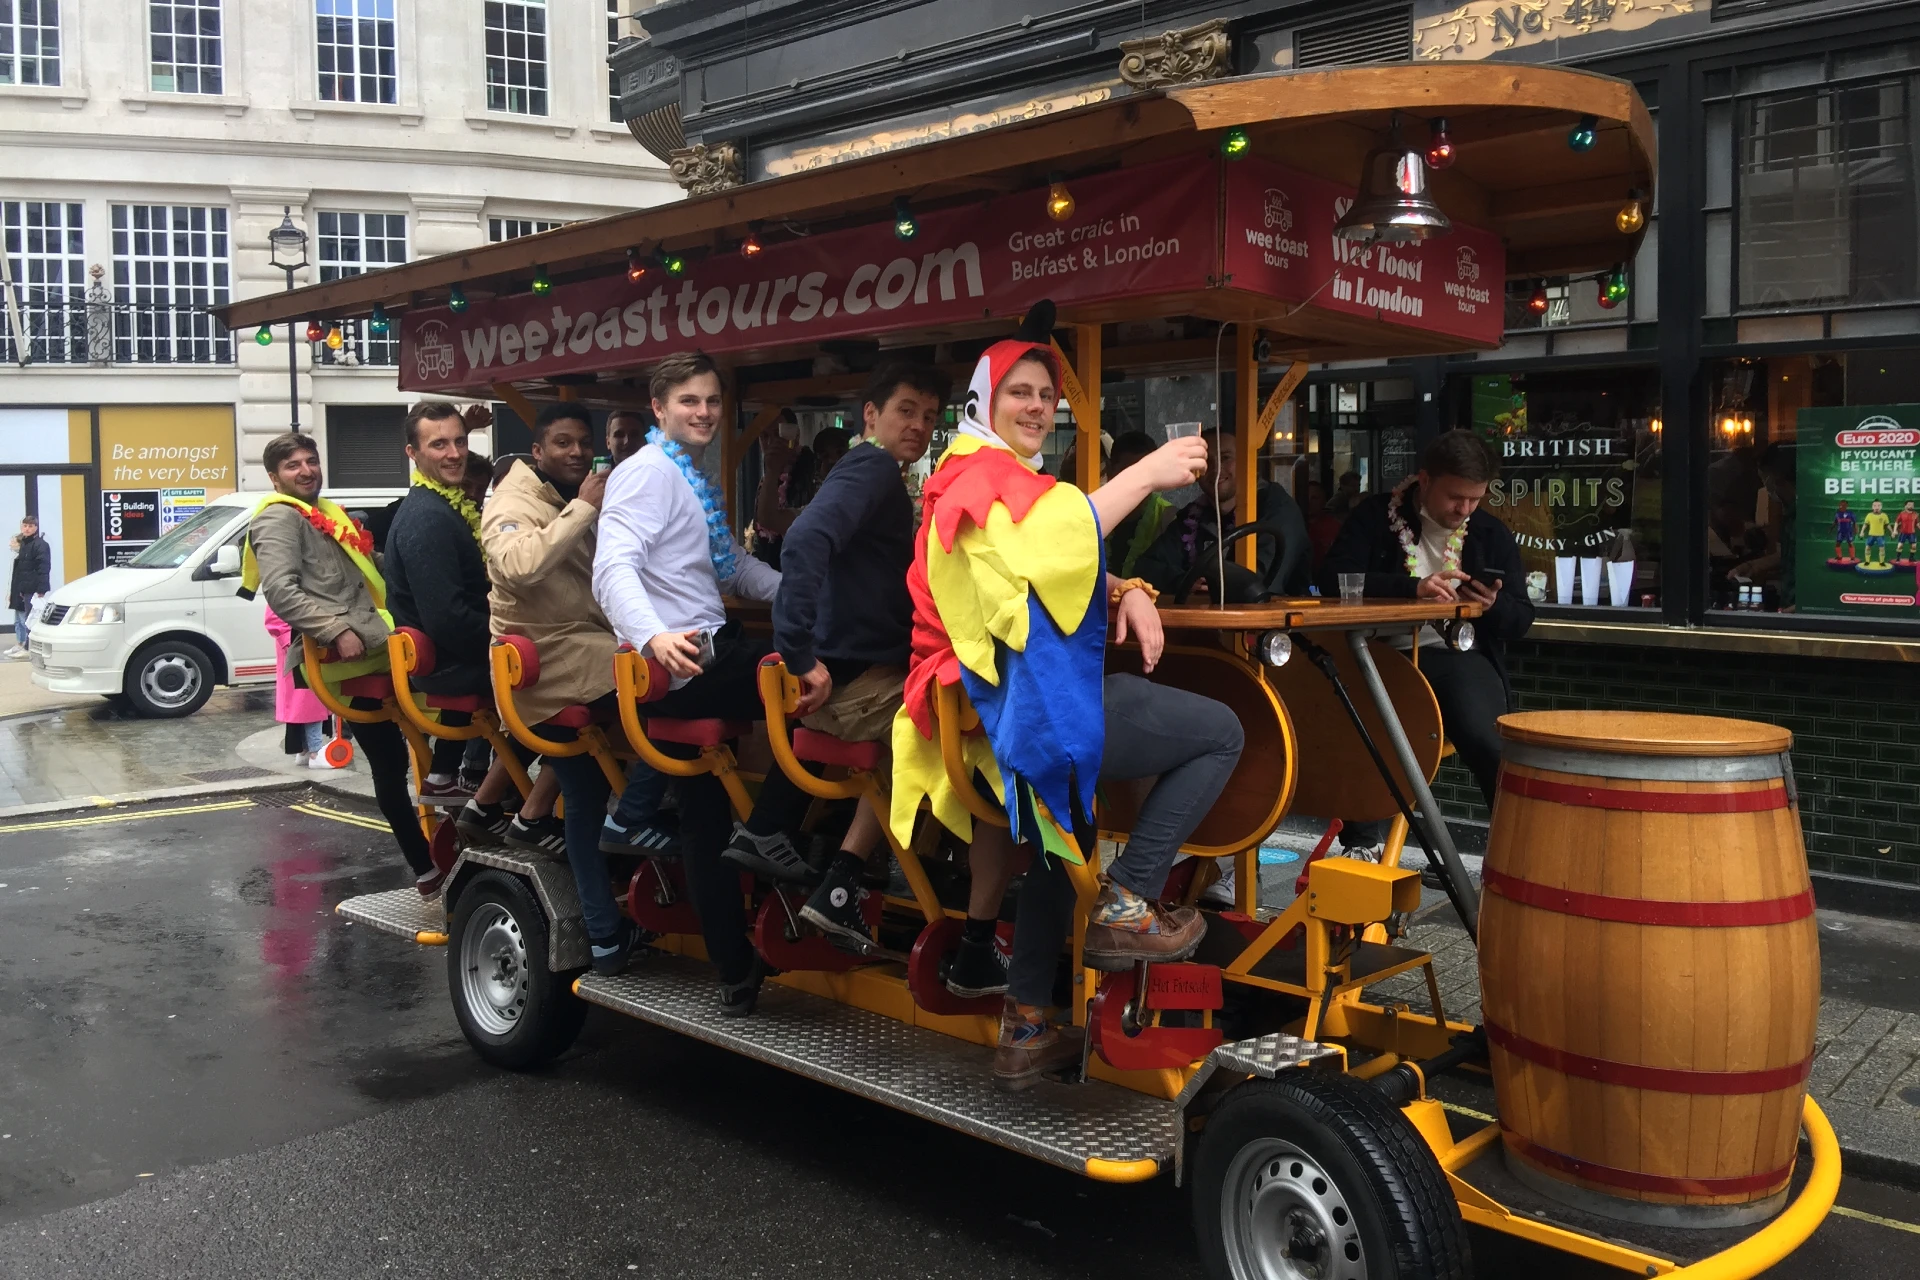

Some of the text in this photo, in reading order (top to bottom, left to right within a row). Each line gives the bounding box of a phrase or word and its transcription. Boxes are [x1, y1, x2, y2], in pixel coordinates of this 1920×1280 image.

[1009, 213, 1139, 252] Great craic in
[1246, 228, 1308, 258] wee toast
[1012, 237, 1179, 281] Belfast & London
[1264, 251, 1289, 269] tours
[1332, 235, 1423, 282] Wee Toast
[1332, 269, 1423, 317] in London
[1444, 281, 1490, 304] wee toast
[1458, 299, 1476, 314] tours
[1503, 438, 1612, 457] BRITISH
[1843, 432, 1914, 444] Euro 2020
[112, 443, 219, 463] Be amongst
[1841, 449, 1916, 459] IF YOU CAN'T
[113, 464, 229, 483] the very best
[1841, 461, 1860, 471] BE
[1488, 477, 1625, 507] SPIRITS
[1824, 477, 1920, 494] BE HERE
[123, 502, 154, 511] Building
[1511, 526, 1617, 551] HISKY GIN
[1152, 978, 1169, 993] Het
